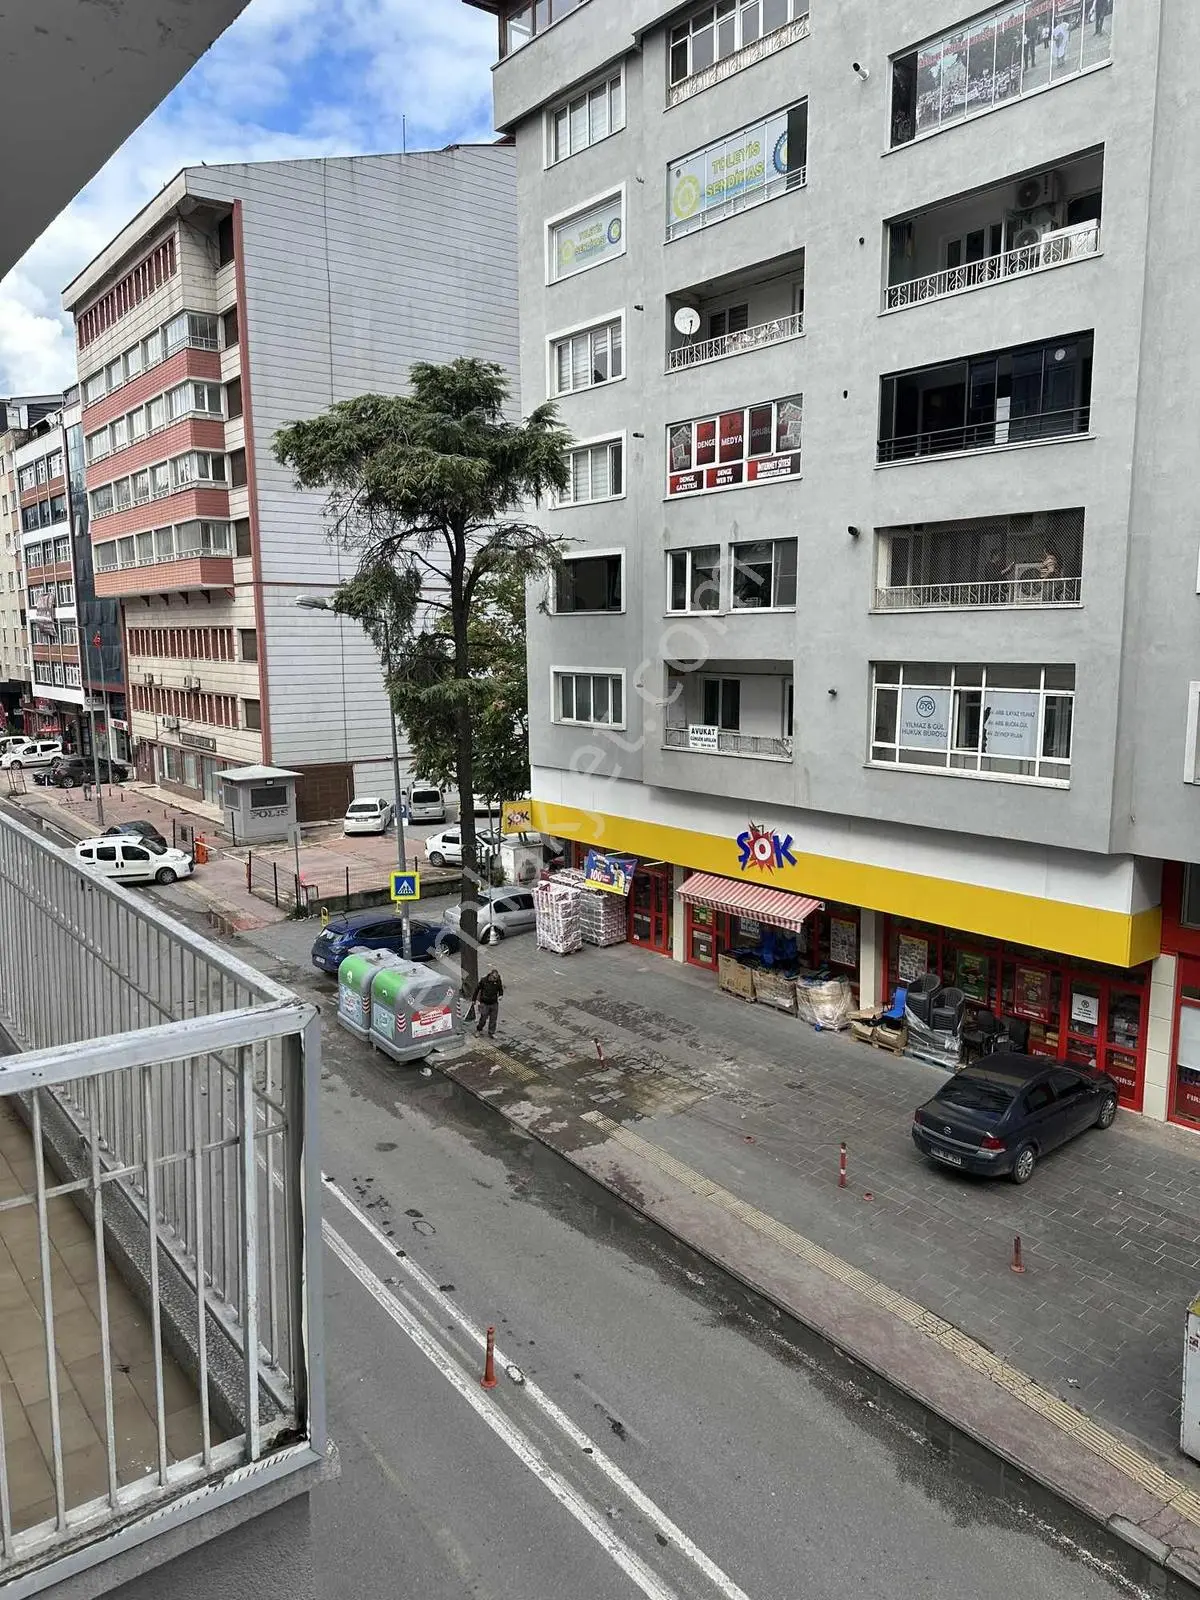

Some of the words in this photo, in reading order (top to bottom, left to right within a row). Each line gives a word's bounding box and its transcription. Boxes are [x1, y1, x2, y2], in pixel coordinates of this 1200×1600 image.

[697, 438, 716, 450] DENGE
[721, 435, 743, 447] MEDYA
[691, 727, 715, 735] AVUKAT
[736, 830, 798, 871] ŞOK
